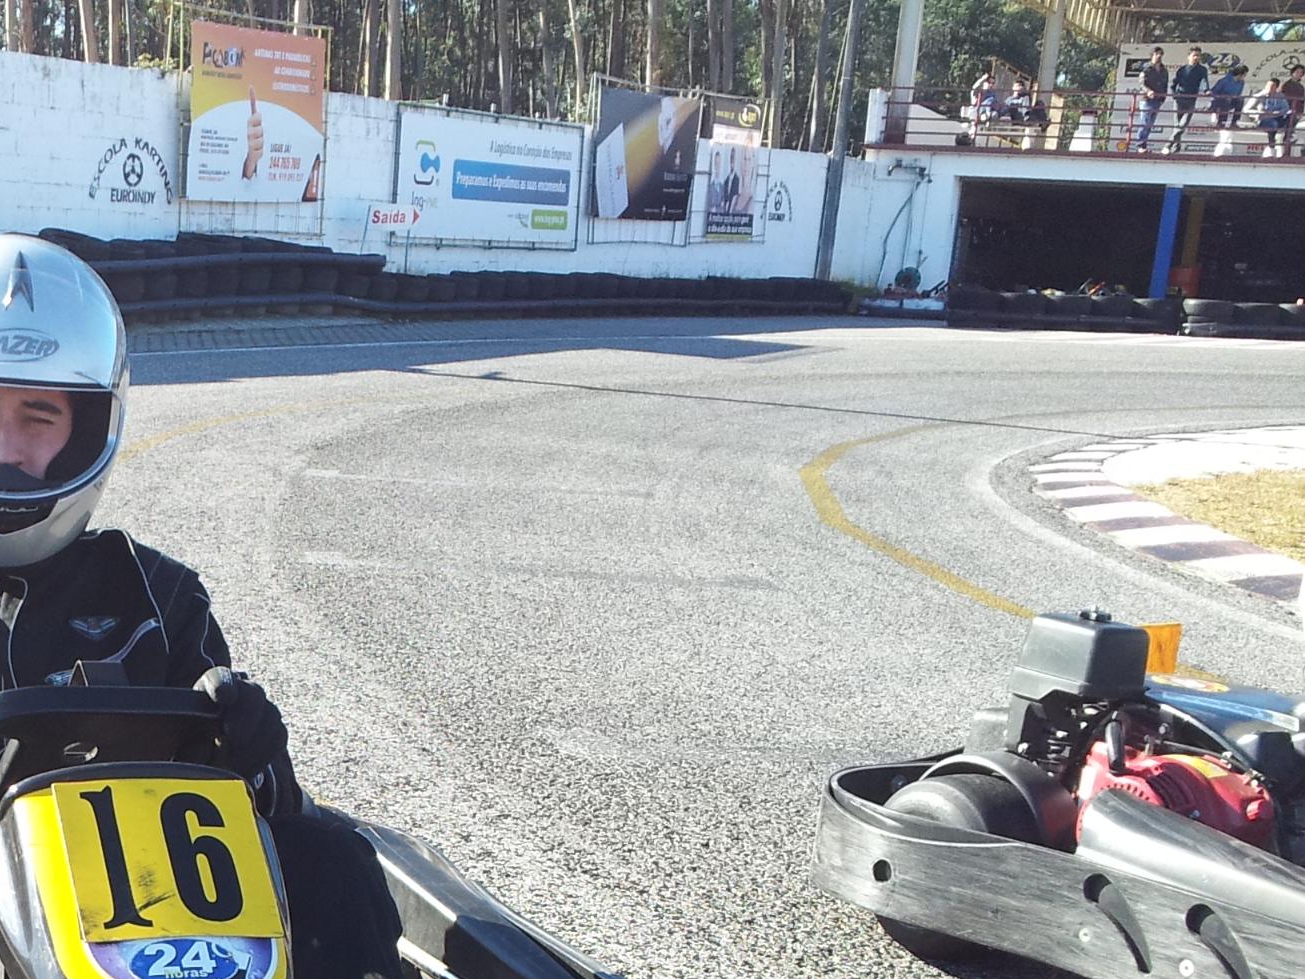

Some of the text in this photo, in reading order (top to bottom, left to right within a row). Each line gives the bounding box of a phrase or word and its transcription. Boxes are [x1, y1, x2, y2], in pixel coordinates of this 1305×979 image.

[110, 188, 156, 204] EUROINDY
[80, 785, 244, 930] 16
[144, 940, 217, 977] 24
